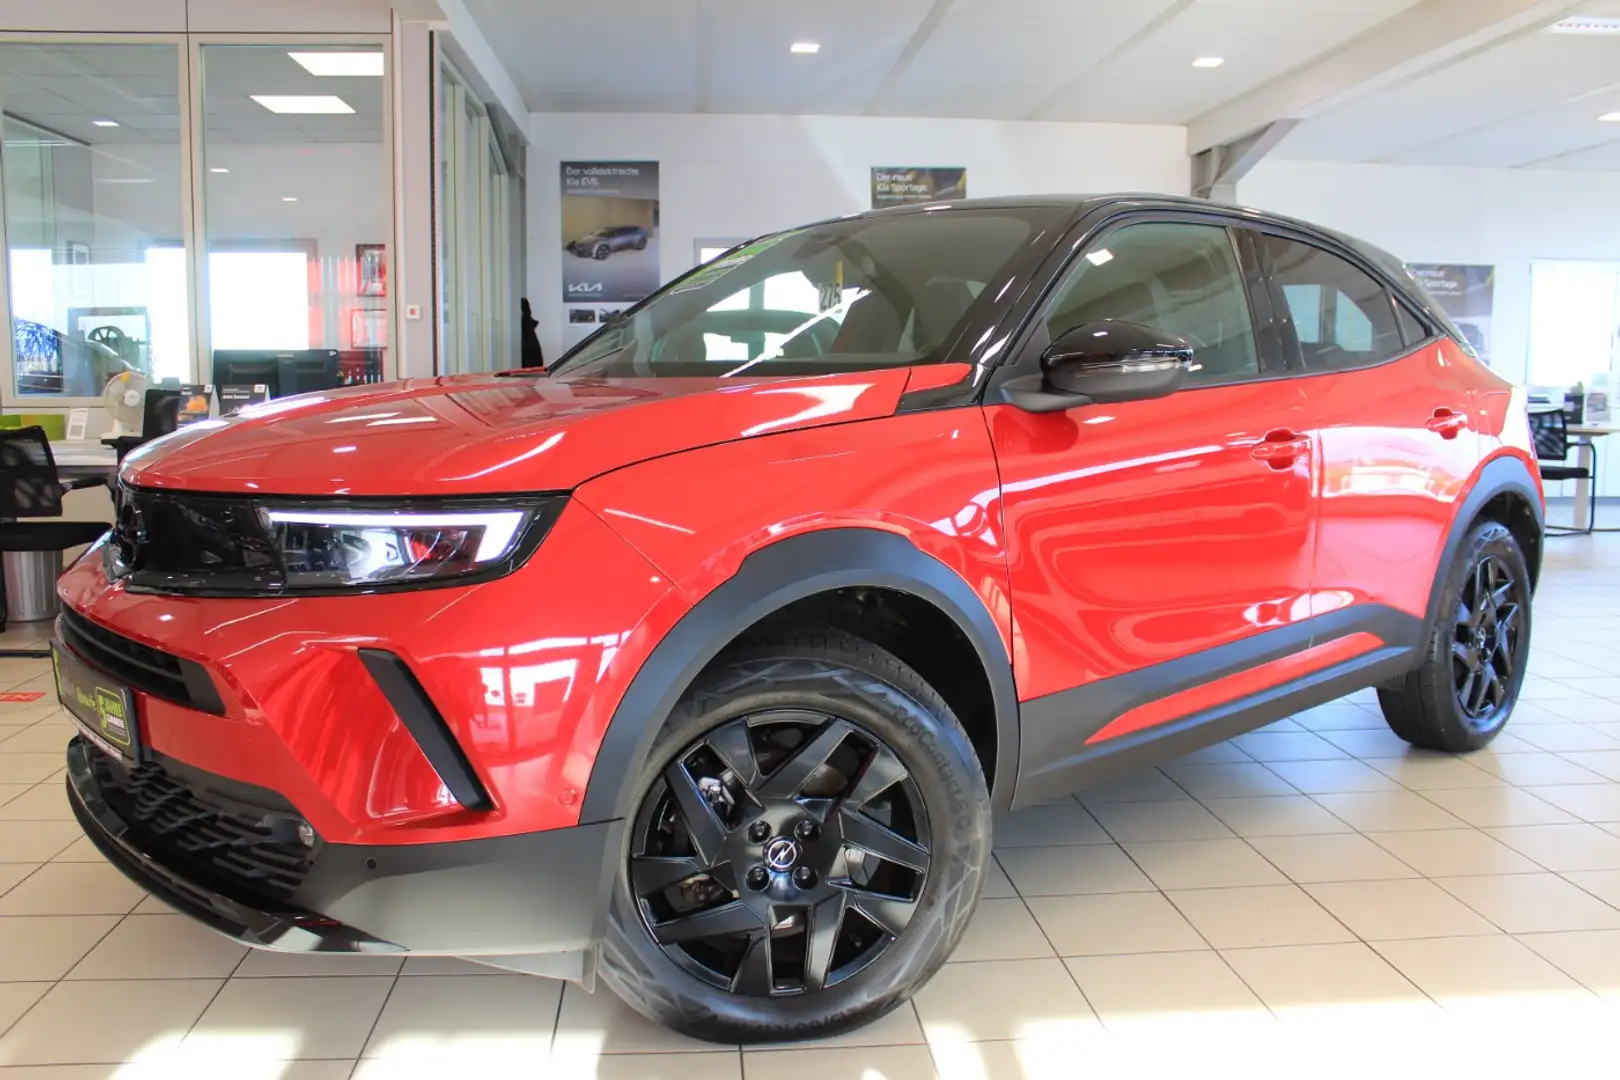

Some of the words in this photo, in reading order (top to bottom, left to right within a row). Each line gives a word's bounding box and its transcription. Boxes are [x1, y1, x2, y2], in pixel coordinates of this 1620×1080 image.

[566, 166, 580, 175] Der
[566, 177, 580, 186] Kia
[876, 173, 890, 181] Der
[876, 183, 889, 192] Kia
[568, 282, 602, 292] KIA
